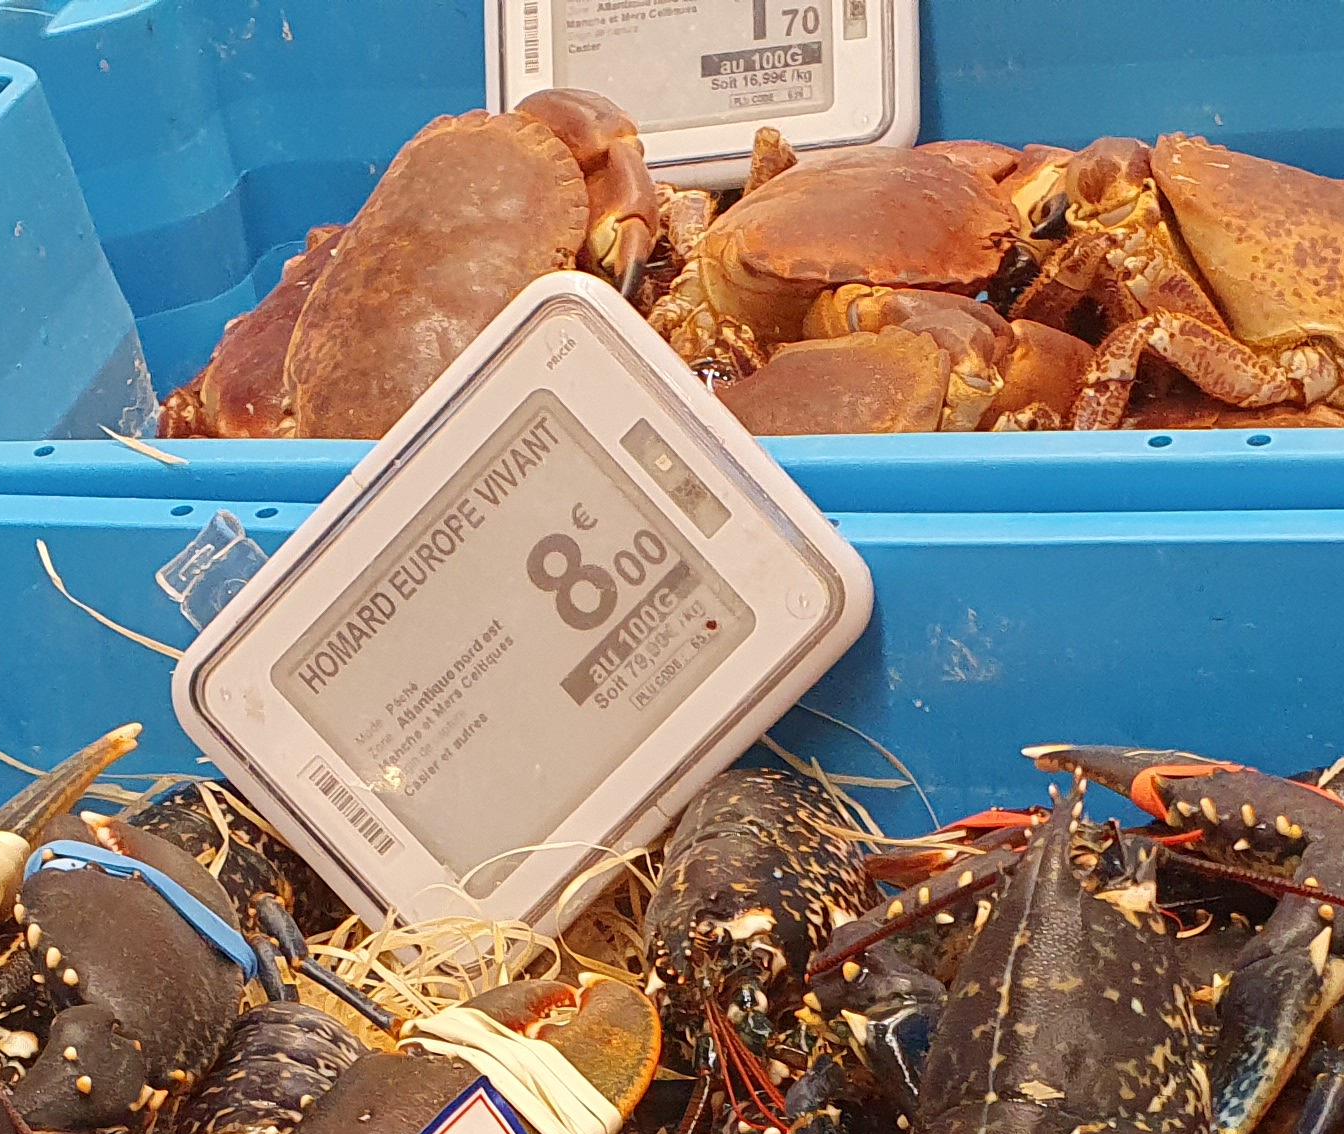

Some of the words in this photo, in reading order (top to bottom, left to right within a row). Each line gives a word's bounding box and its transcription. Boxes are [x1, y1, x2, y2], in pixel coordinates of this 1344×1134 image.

[720, 59, 745, 74] au
[752, 48, 803, 70] 100G
[781, 6, 820, 36] 70
[711, 77, 737, 90] Soit
[743, 70, 787, 87] 16,99€
[791, 69, 812, 83] /kg
[298, 592, 397, 695] HOMARD
[387, 498, 486, 601] EUROPE
[473, 416, 559, 506] VIVANT
[526, 533, 618, 630] 8
[572, 503, 599, 531] €
[613, 529, 669, 587] 00
[396, 669, 456, 731] Atlantique
[453, 638, 484, 673] nord
[482, 619, 503, 643] est
[588, 649, 622, 685] au
[618, 587, 681, 649] 100G
[421, 716, 435, 730] et
[431, 688, 463, 718] Mers
[460, 635, 514, 689] Celtiques
[593, 674, 629, 709] Soit
[635, 683, 658, 706] PLU
[403, 759, 440, 797] Casier
[440, 747, 453, 762] et
[452, 713, 489, 750] autres
